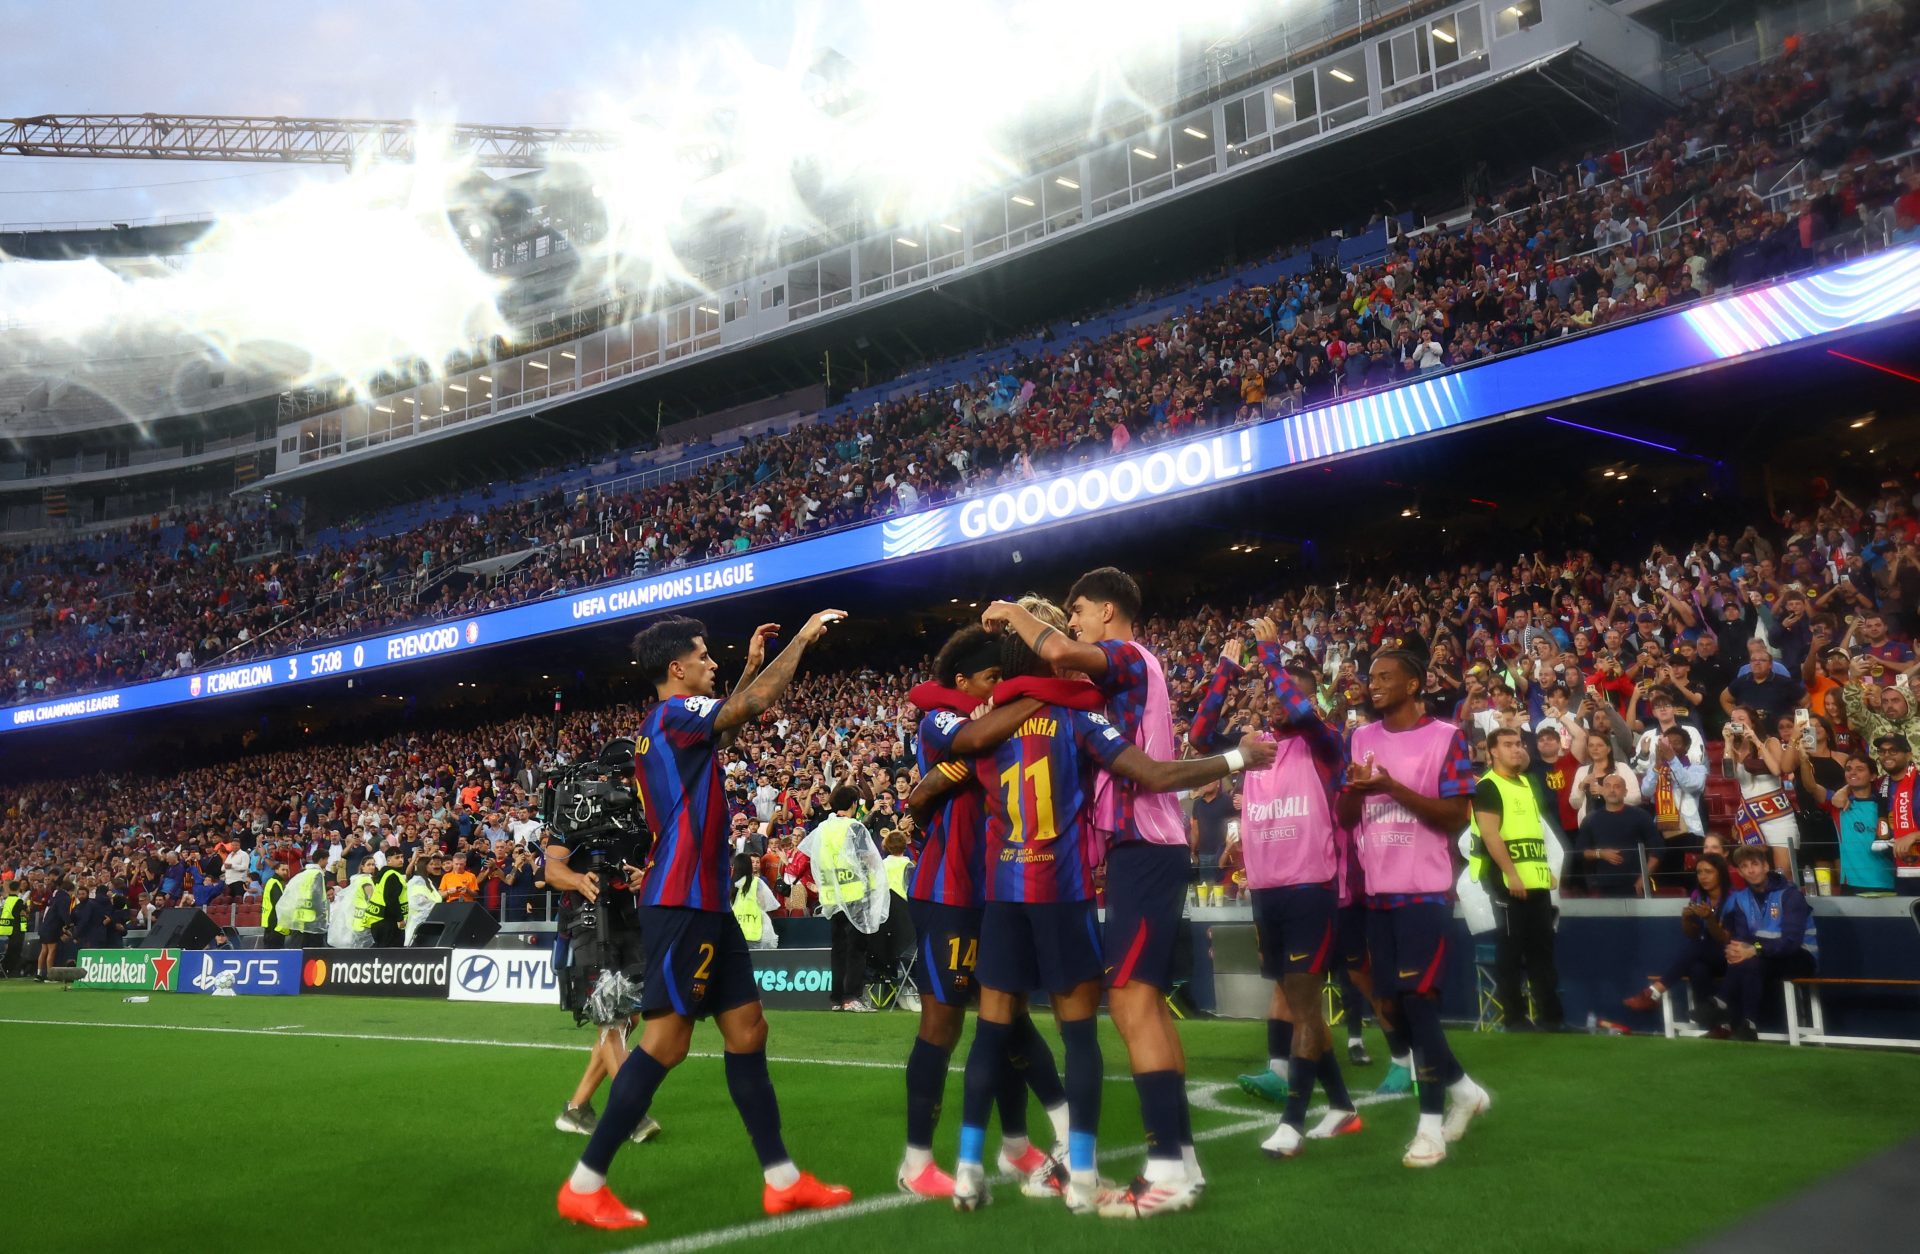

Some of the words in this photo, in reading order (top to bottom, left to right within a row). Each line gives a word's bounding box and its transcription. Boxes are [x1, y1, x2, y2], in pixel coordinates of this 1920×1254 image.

[959, 429, 1253, 538] GOOOOOOOL!
[573, 599, 607, 619] UEFA
[609, 576, 692, 612] CHAMPIONS
[696, 563, 754, 593] LEAGUE
[387, 627, 459, 660] FEYENOORD
[288, 658, 298, 680] 3
[311, 650, 342, 675] 57:08
[354, 645, 364, 667] 0
[13, 711, 35, 724] UEFA
[36, 702, 85, 721] CHAMPIONS
[86, 694, 120, 713] LEAGUE
[1000, 756, 1058, 843] 11
[1749, 801, 1774, 817] FC
[1900, 791, 1909, 829] BARÇA
[79, 956, 146, 983] Heineken
[330, 956, 448, 986] mastercard
[693, 943, 714, 980] 2
[948, 936, 978, 972] 14
